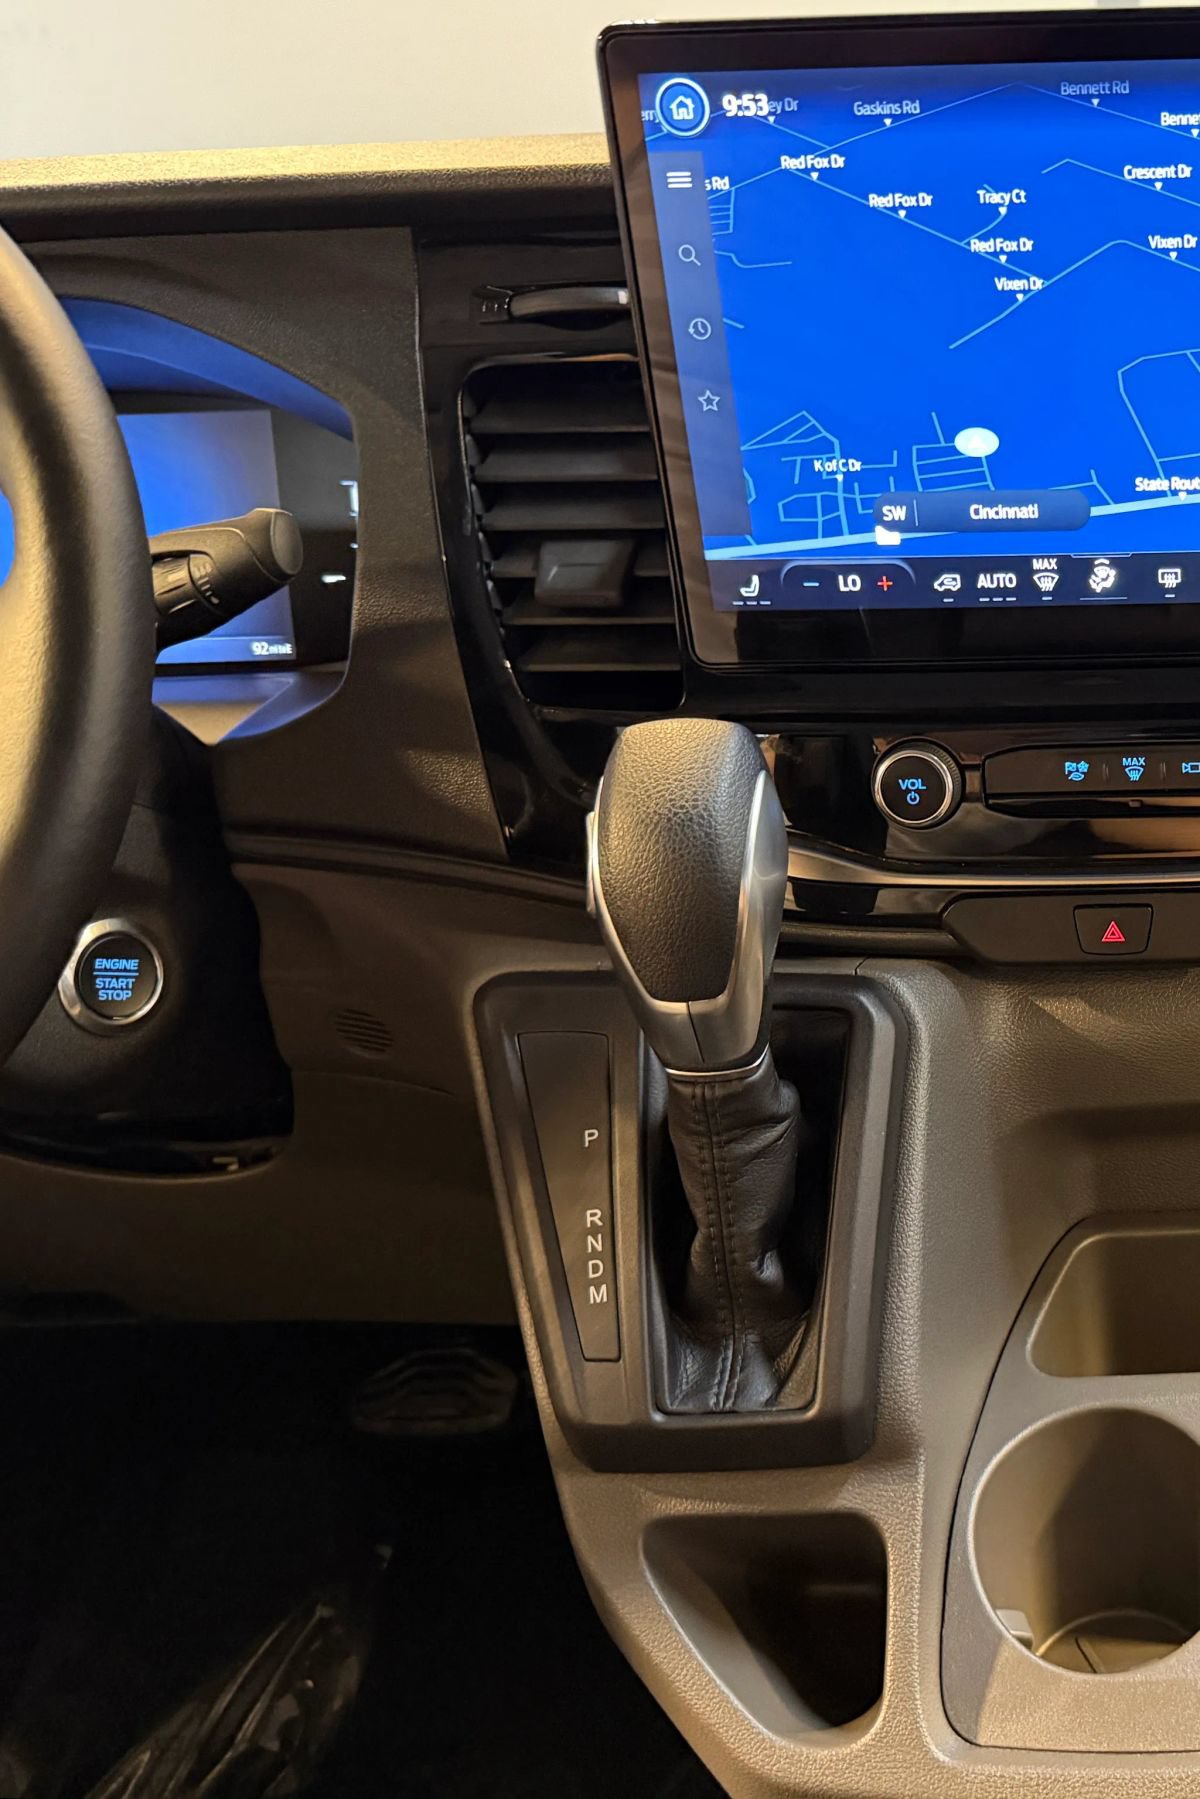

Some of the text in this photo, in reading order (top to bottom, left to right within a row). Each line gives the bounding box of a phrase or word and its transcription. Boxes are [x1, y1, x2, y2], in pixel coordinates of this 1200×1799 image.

[1060, 80, 1130, 95] Bennett Rd
[722, 93, 769, 117] 9:53
[785, 98, 799, 112] Dr
[853, 100, 920, 116] Gaskins Rd
[780, 154, 846, 169] Red Fox Dr
[1123, 164, 1192, 180] Crescent Dr
[712, 176, 730, 190] Rd
[868, 193, 933, 208] Red Fox Dr
[976, 189, 1026, 206] Tracy Ct
[970, 237, 1034, 253] Red Fox Dr
[1148, 234, 1198, 249] Vixen Dr
[994, 276, 1044, 291] Vixen Dr
[813, 458, 862, 472] K of C Dr
[1135, 477, 1170, 492] State
[882, 505, 907, 521] SW
[969, 503, 1039, 520] Cincinnati
[1032, 558, 1058, 570] MAX
[838, 575, 861, 592] LO
[977, 573, 1017, 588] AUTO
[1122, 757, 1146, 767] MAX
[899, 778, 927, 791] VOL
[95, 958, 139, 970] ENGINE
[95, 977, 135, 989] START
[98, 989, 132, 1001] STOP
[584, 1128, 599, 1147] P
[586, 1208, 603, 1228] R
[587, 1233, 603, 1253] N
[588, 1259, 604, 1279] D
[589, 1283, 608, 1305] M
